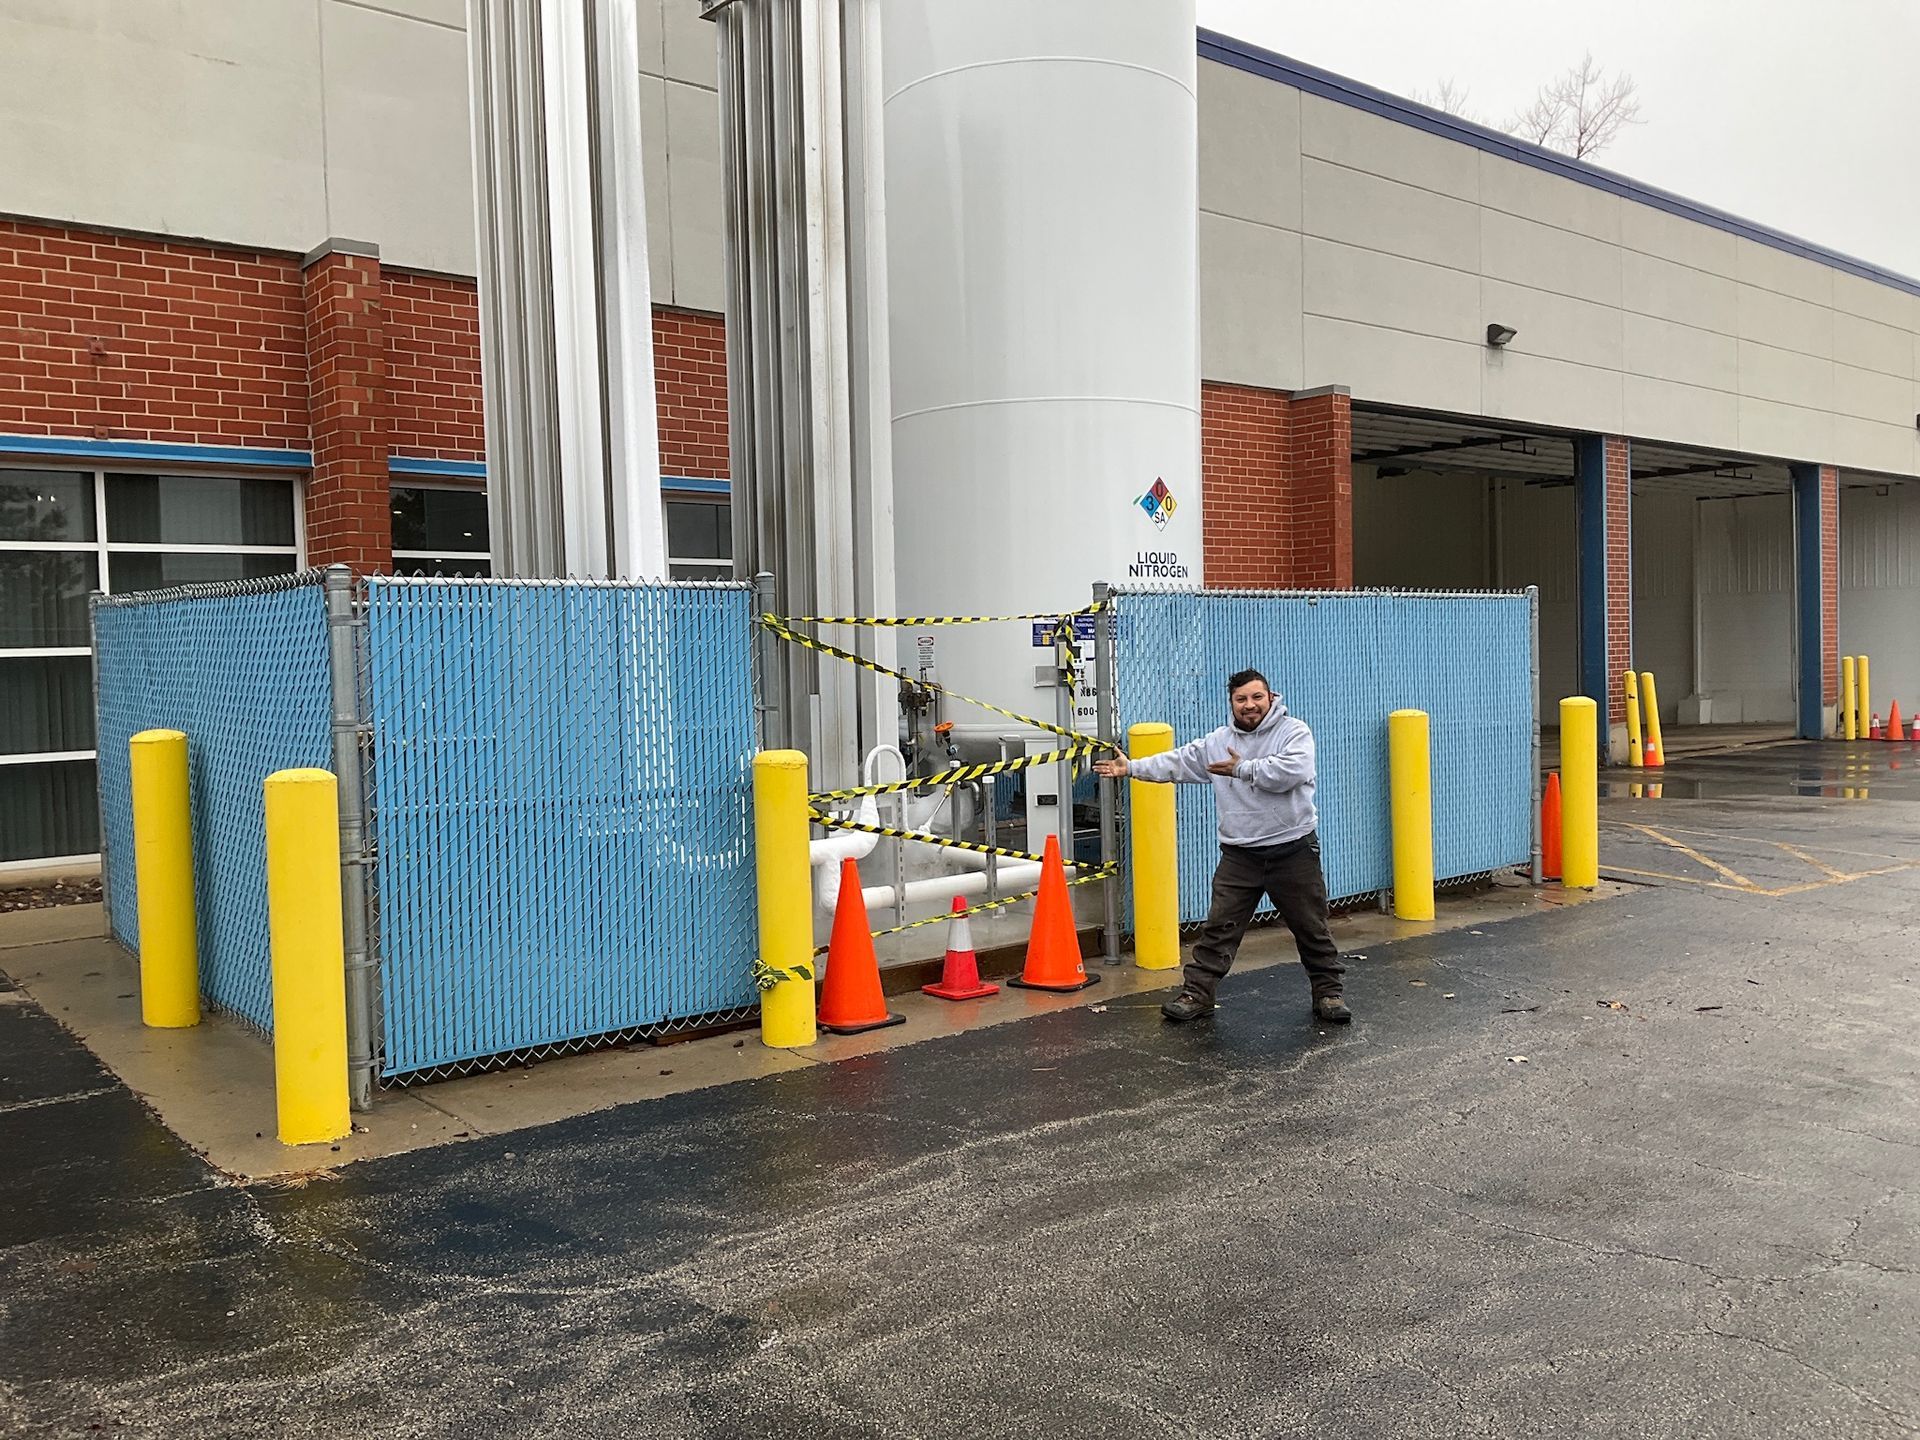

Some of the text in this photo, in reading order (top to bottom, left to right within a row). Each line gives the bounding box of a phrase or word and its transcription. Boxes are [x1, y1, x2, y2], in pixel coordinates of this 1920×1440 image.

[1155, 481, 1164, 498] 0
[1146, 495, 1173, 512] 3 0
[1154, 511, 1166, 524] SA
[1137, 551, 1178, 565] LIQUID
[1129, 564, 1188, 578] NITROGEN
